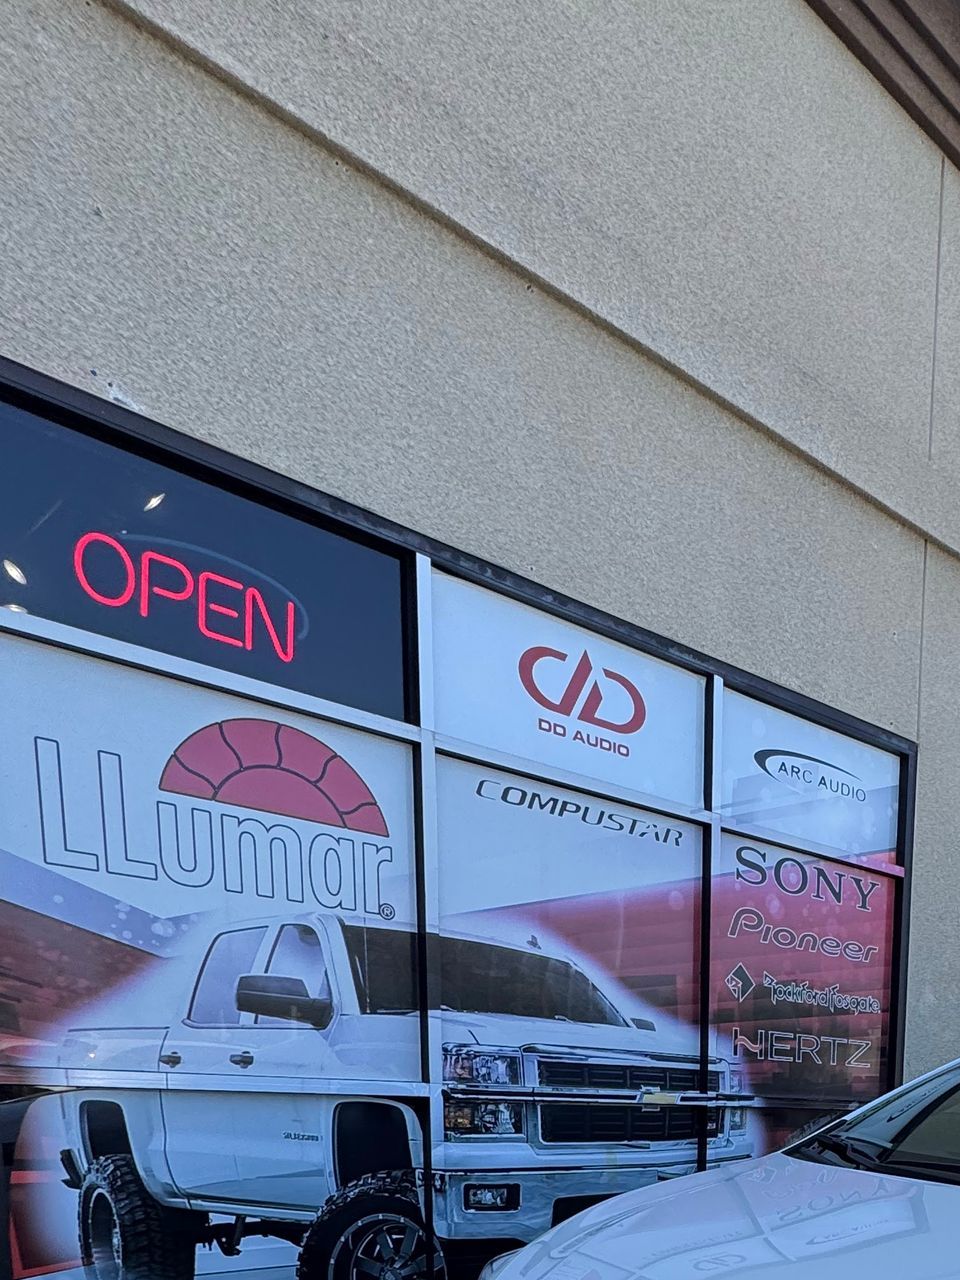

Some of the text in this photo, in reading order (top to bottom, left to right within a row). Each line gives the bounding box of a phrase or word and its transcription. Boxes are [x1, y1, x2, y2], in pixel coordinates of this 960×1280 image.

[73, 531, 296, 663] OPEN
[538, 717, 630, 758] DD AUDIO
[777, 760, 866, 803] ARC AUDIO
[475, 777, 684, 848] COMPUSTAR
[735, 844, 882, 913] SONY
[727, 906, 880, 964] Pioneer
[732, 1026, 872, 1068] HERTZ
